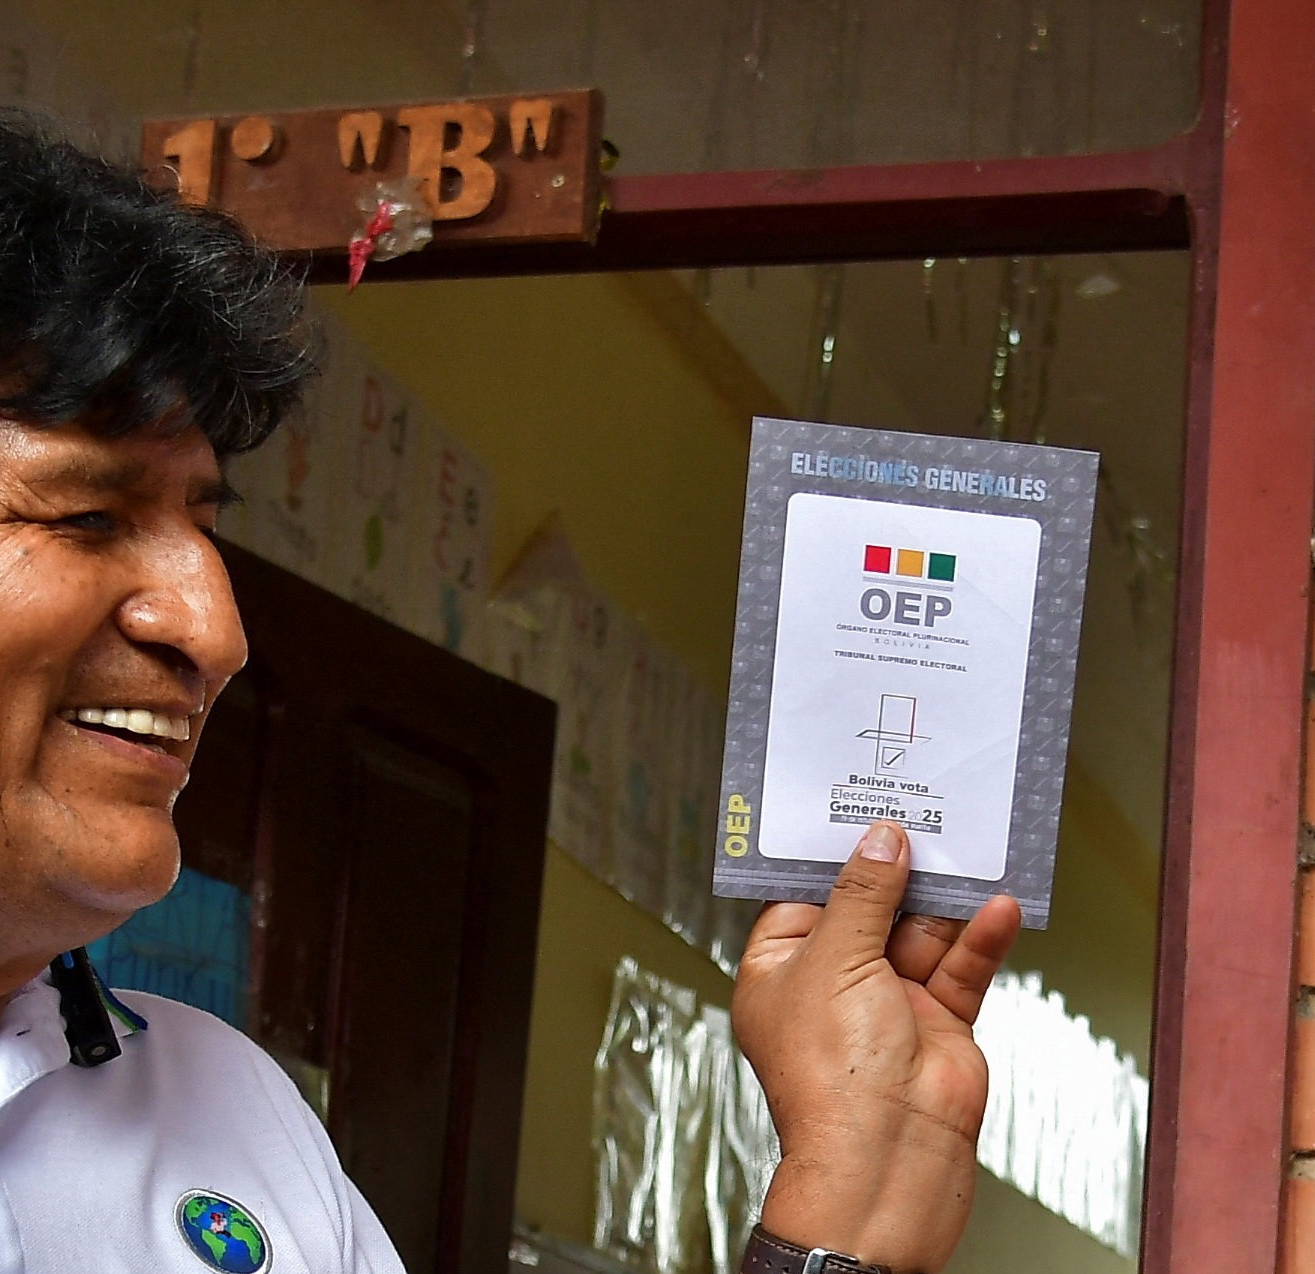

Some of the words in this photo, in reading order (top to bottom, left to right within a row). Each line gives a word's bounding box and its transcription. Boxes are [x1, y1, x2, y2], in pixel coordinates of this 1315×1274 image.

[790, 451, 919, 488] ELECCIONES
[925, 466, 1047, 502] GENERALES
[860, 588, 952, 628] OEP
[869, 628, 911, 639] ELECTORAL
[834, 650, 876, 661] TRIBUNAL
[878, 655, 918, 666] SUPREMO
[919, 660, 968, 673] ELECTORAL
[849, 774, 895, 789] Bolivia
[900, 782, 929, 794] vota
[831, 788, 900, 806] Elecciones
[830, 801, 906, 819] Generales
[724, 793, 752, 858] OEP
